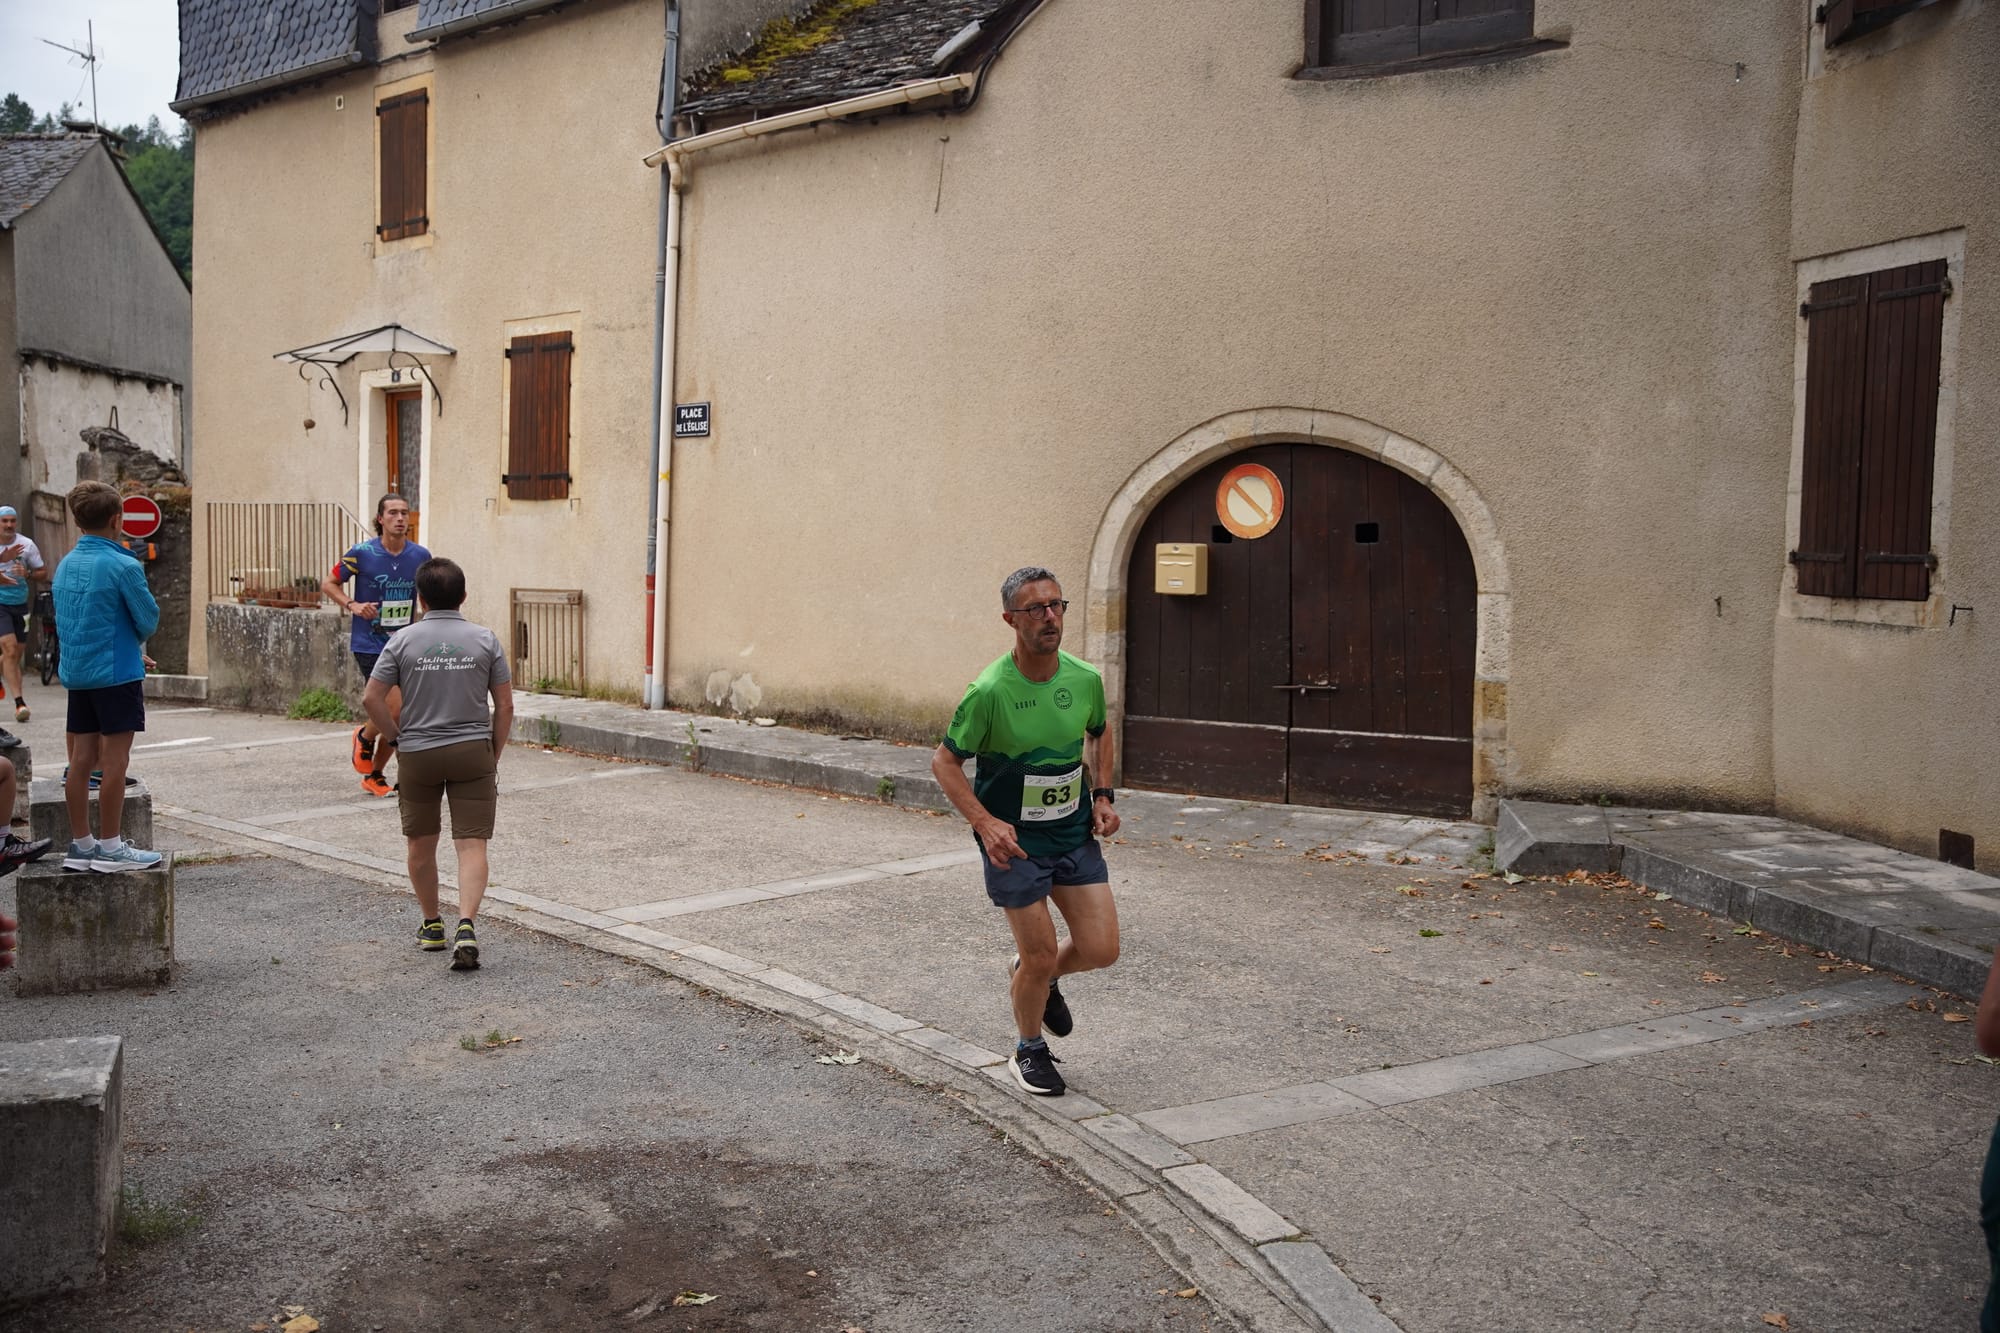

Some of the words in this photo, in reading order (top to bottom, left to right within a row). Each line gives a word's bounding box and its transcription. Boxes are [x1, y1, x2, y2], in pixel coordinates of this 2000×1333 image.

[681, 408, 703, 418] PLACE
[676, 423, 683, 432] DE
[387, 606, 409, 618] 117
[416, 656, 457, 665] Challenge
[1041, 785, 1071, 806] 63
